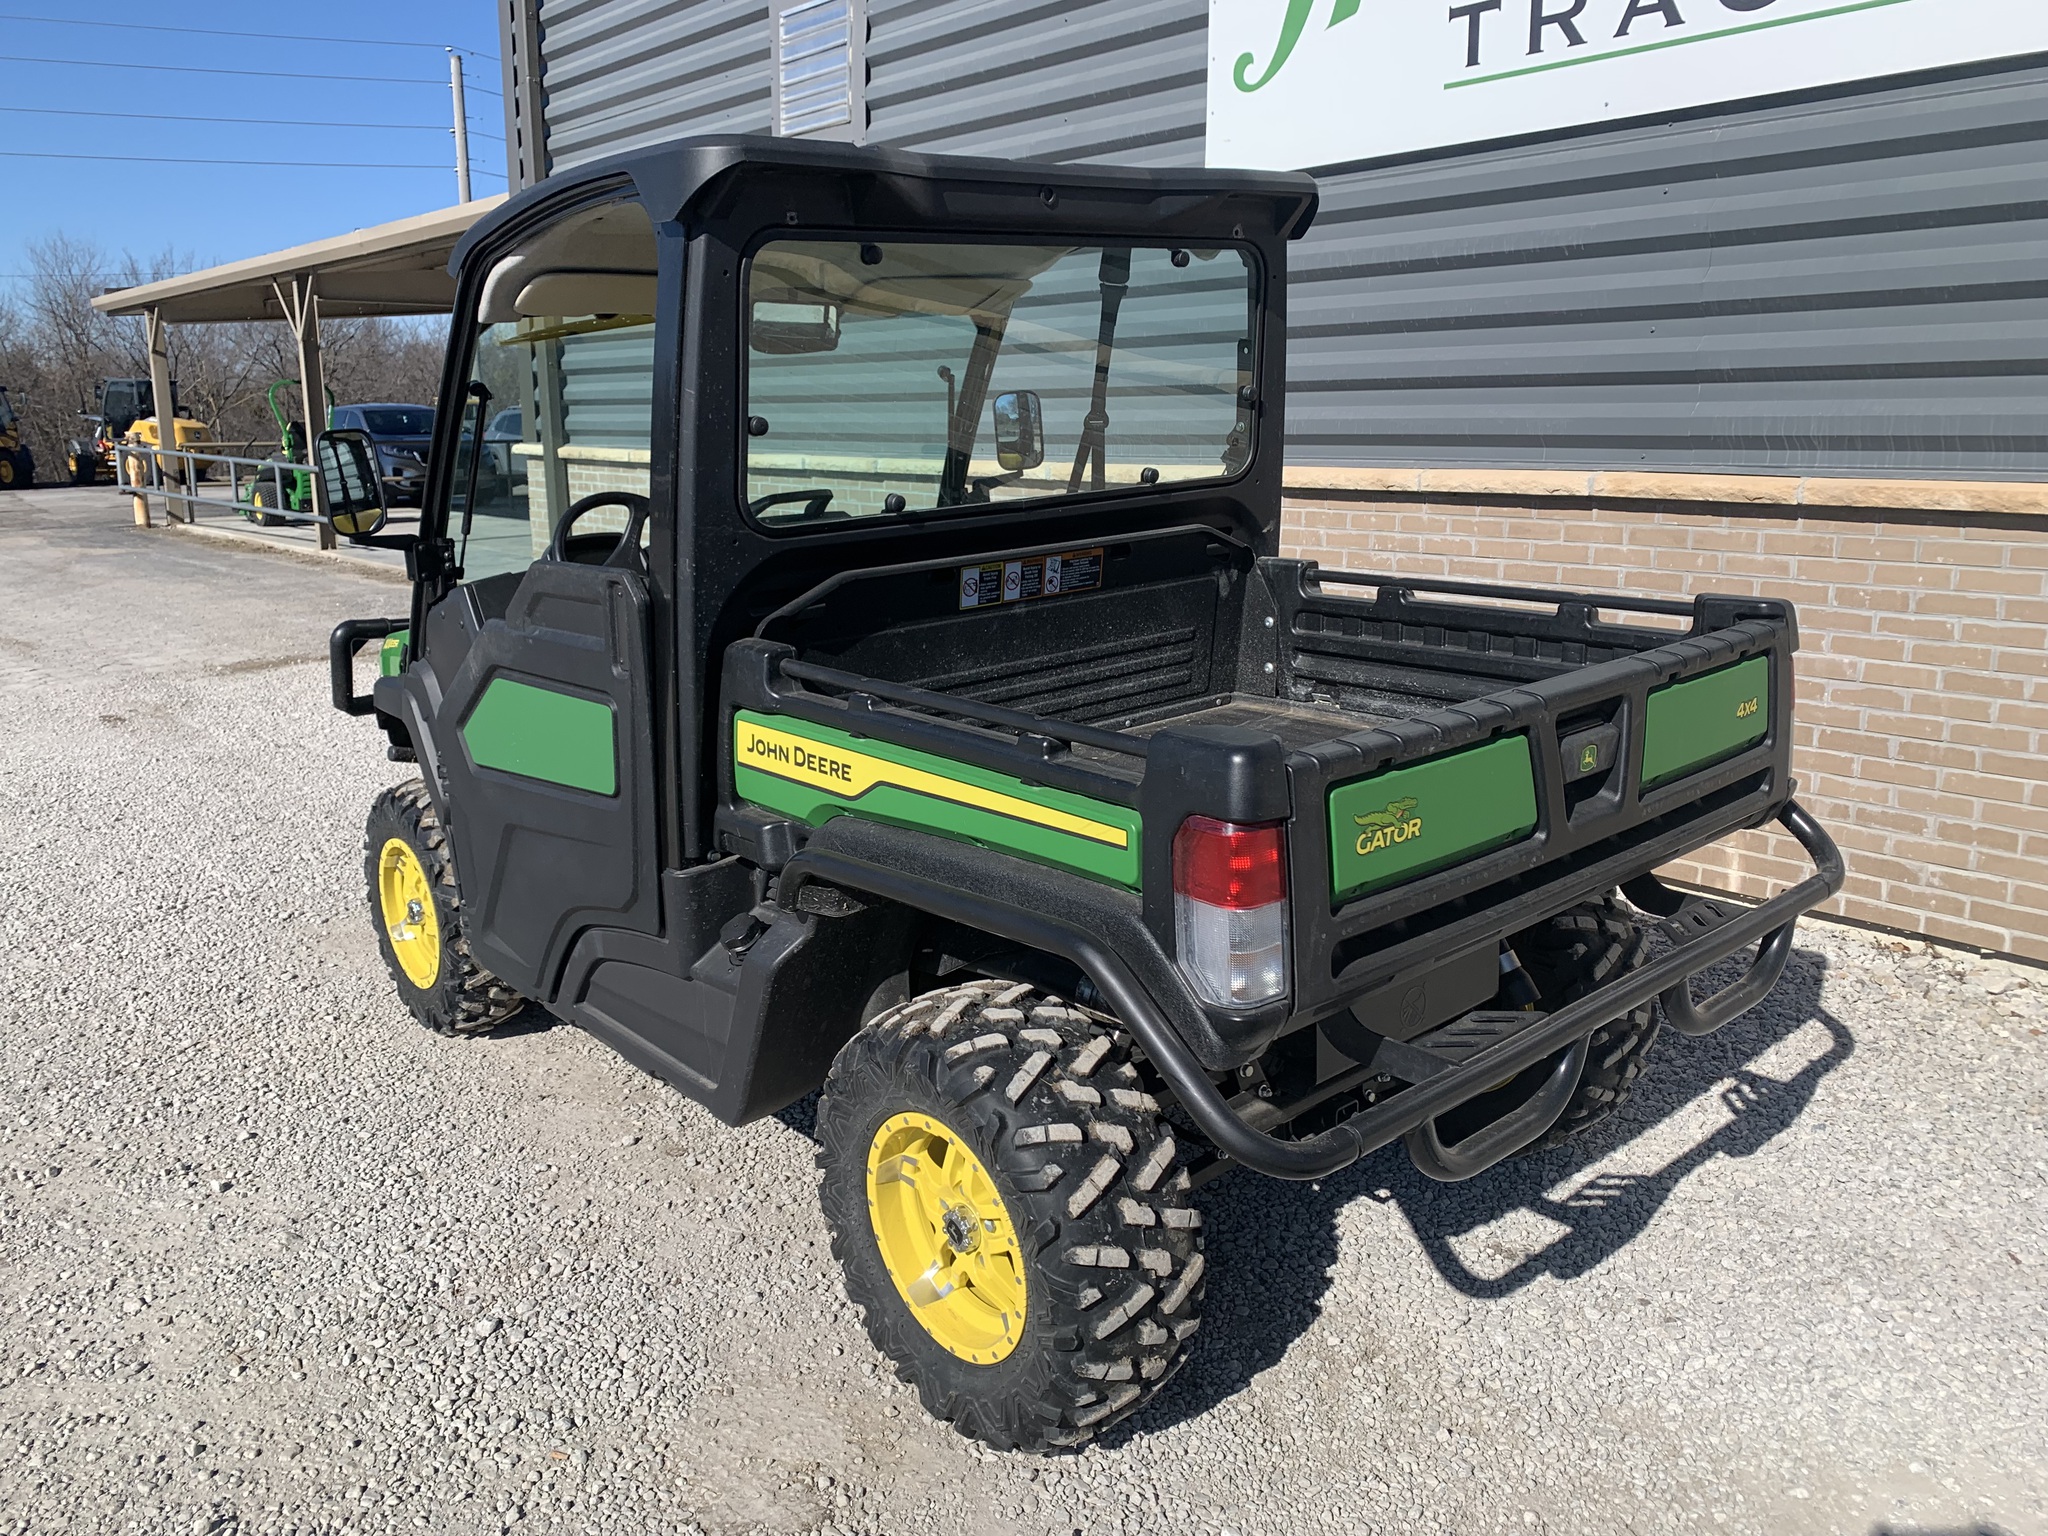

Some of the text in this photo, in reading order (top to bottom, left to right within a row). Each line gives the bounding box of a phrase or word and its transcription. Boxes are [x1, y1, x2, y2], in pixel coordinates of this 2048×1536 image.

[1448, 0, 1777, 67] TRA
[747, 734, 852, 782] JOHN DEERE
[1356, 817, 1422, 856] GATOR
